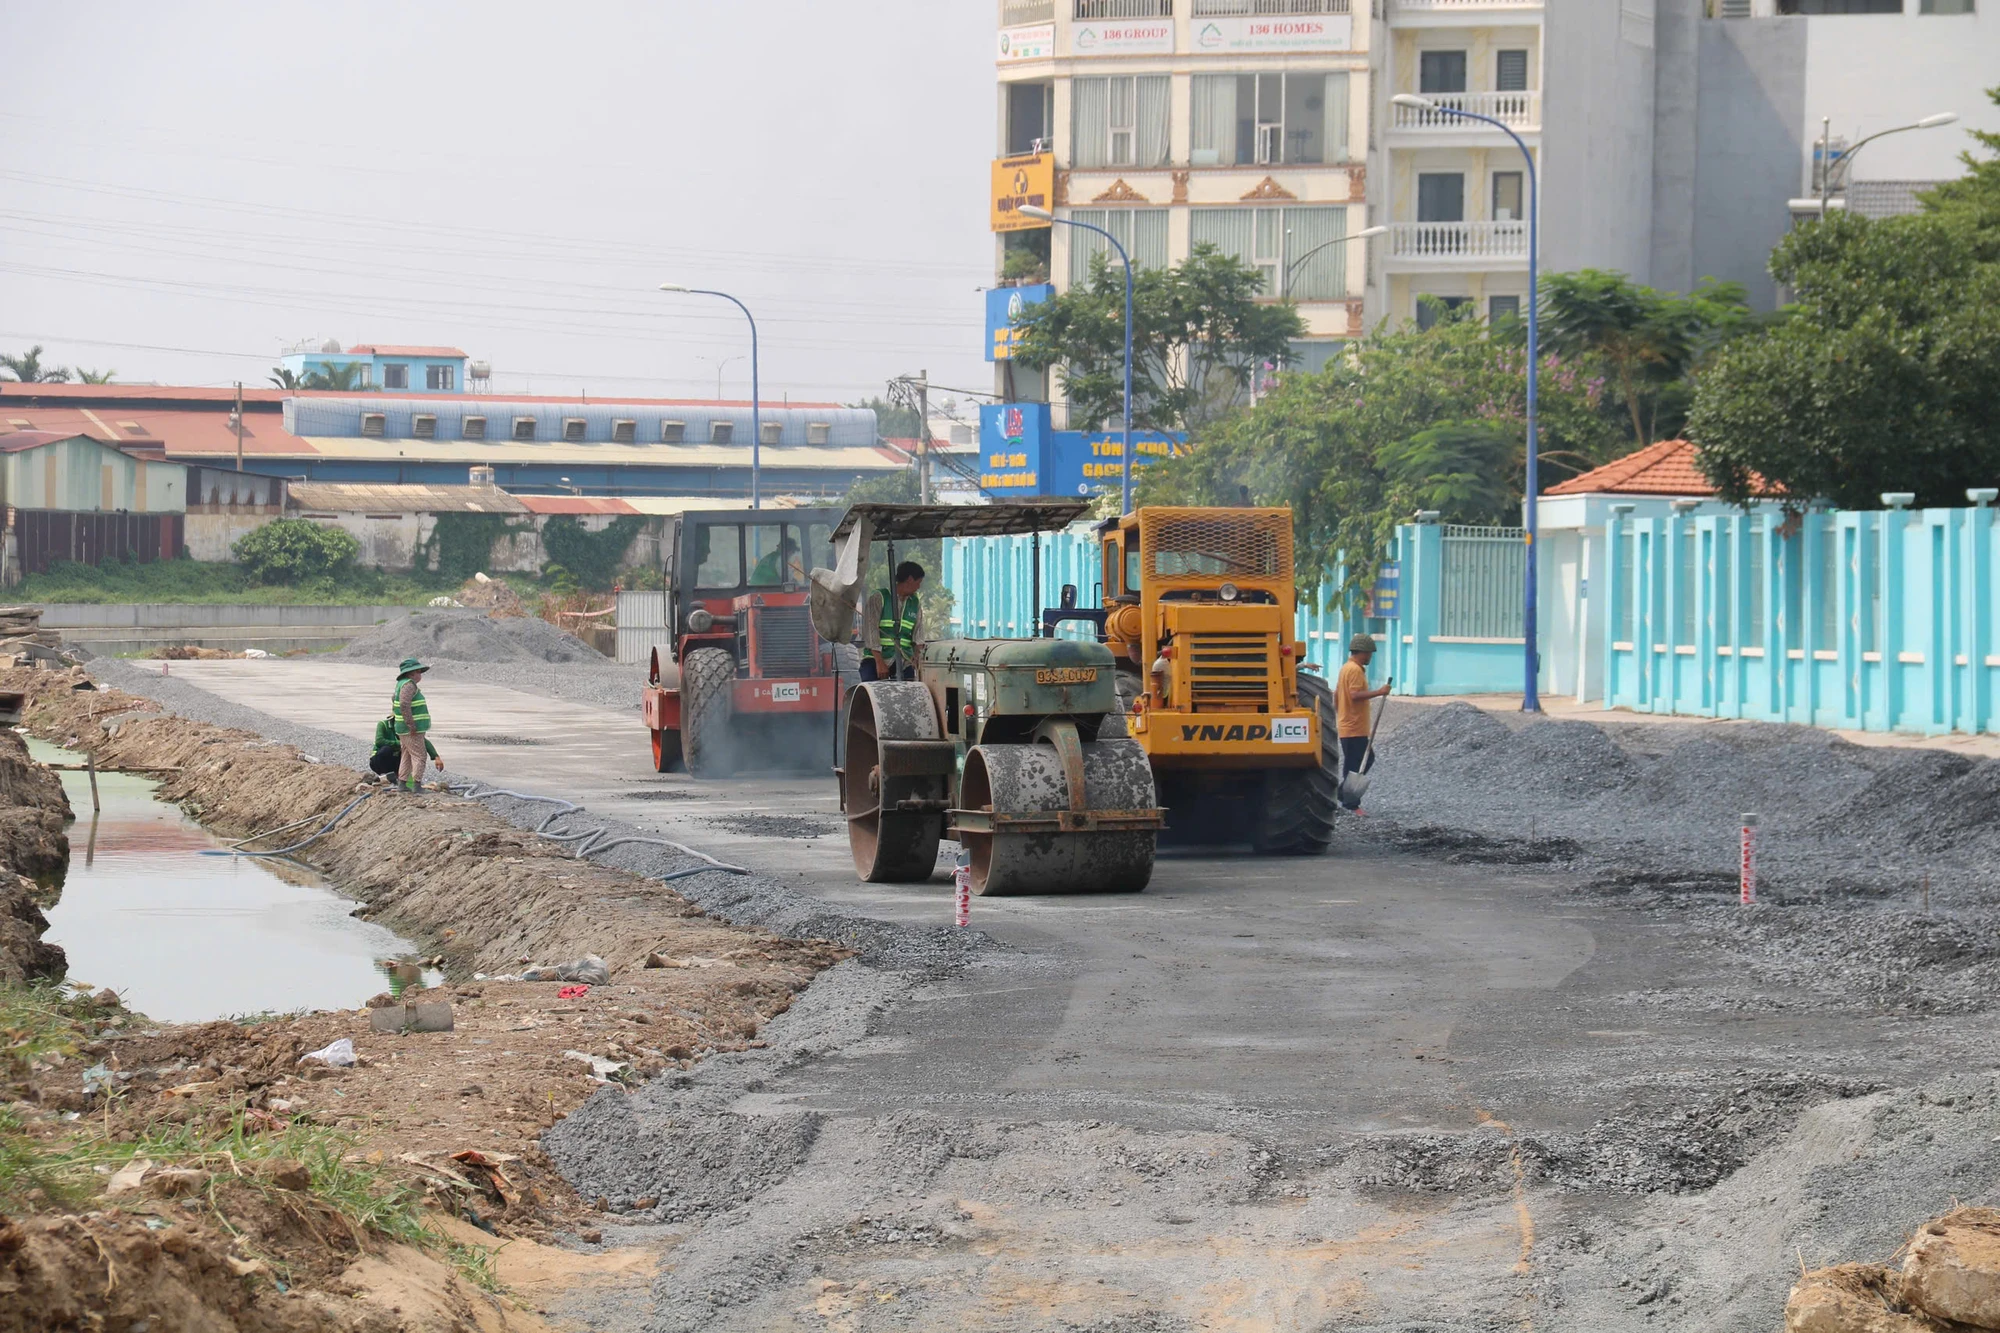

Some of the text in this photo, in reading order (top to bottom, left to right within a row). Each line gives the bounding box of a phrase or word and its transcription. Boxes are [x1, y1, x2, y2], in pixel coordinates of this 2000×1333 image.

[1103, 28, 1168, 40] 136 GROUP
[1249, 22, 1324, 35] 136 HOMES
[782, 688, 798, 696] CC1
[1181, 724, 1272, 742] YNAP
[1284, 725, 1307, 736] CC1
